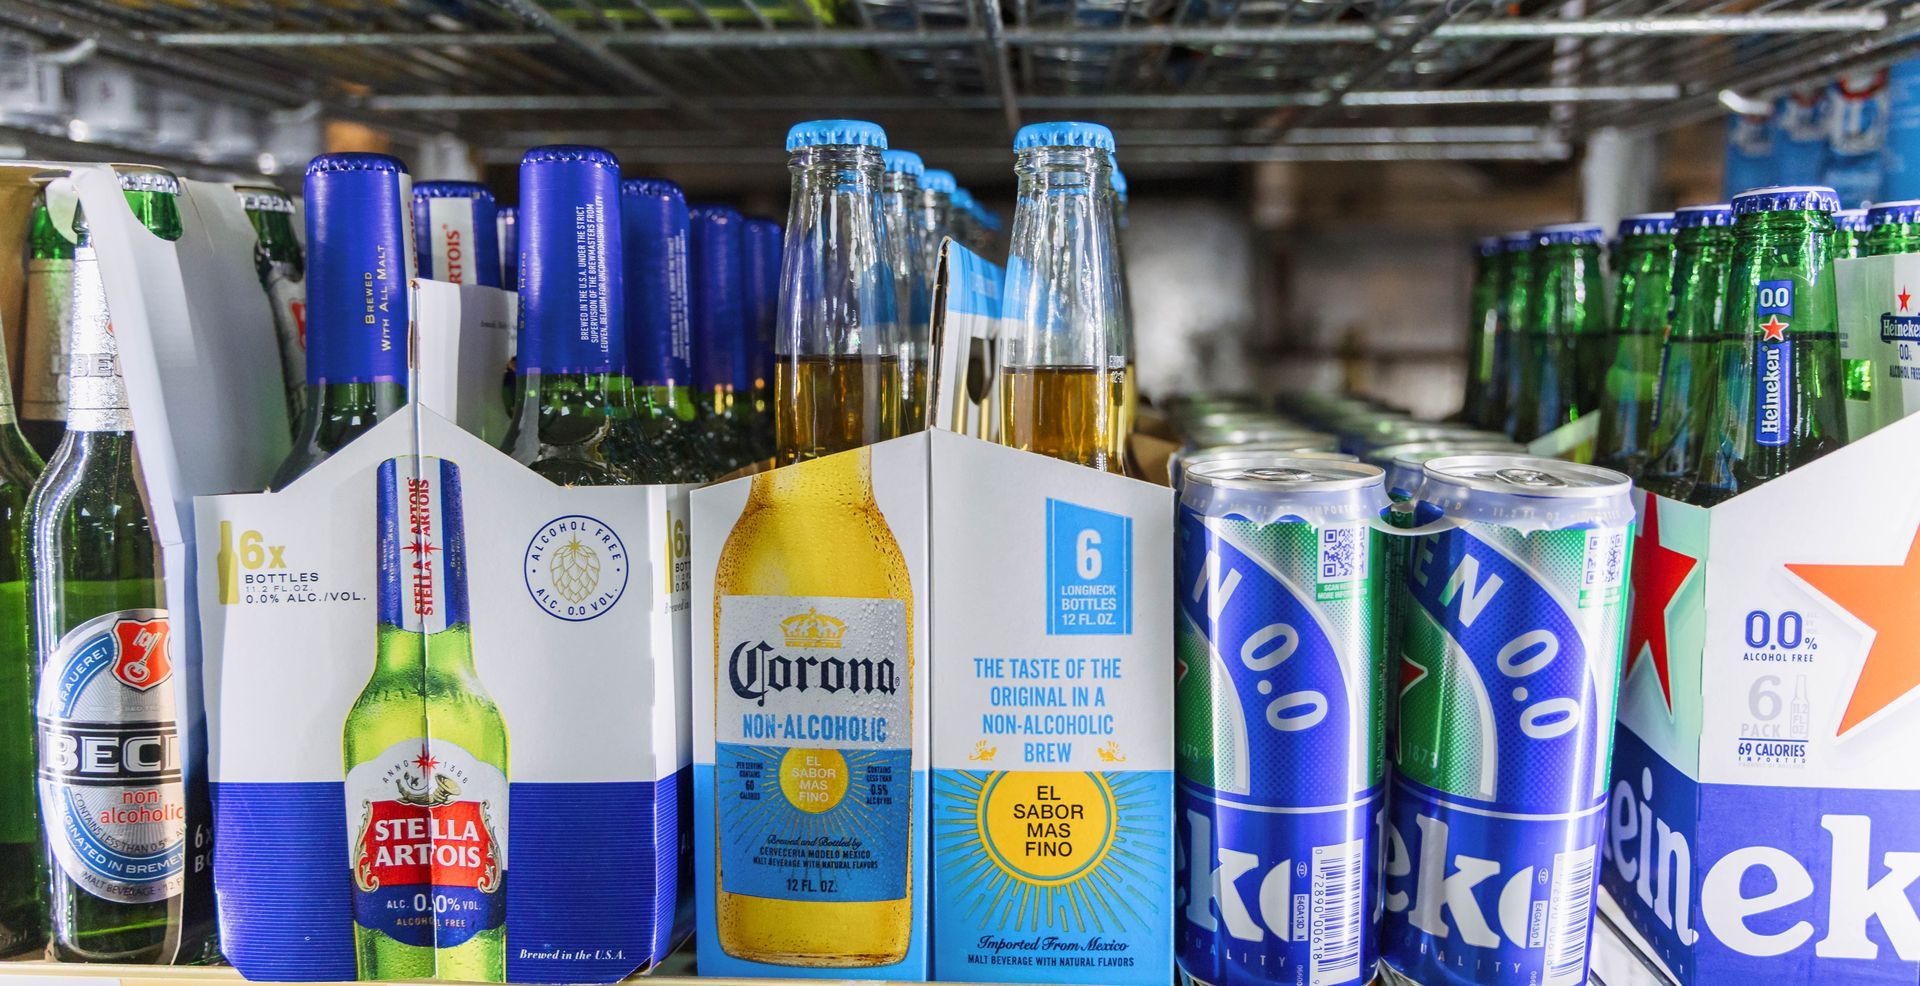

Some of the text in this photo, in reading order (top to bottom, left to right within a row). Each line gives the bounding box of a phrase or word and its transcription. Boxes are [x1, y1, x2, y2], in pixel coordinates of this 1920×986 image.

[576, 206, 589, 341] BREWED IN THE U.S.A. UNDER THE STRICT
[586, 204, 599, 344] SUPERVISION OF THE BREWMASTERS FROM
[364, 272, 376, 325] BREWED
[377, 244, 392, 352] WITH ALL MALT
[1760, 287, 1789, 308] 0.0
[599, 297, 608, 325] BELGIUM
[1761, 348, 1780, 434] Heineken
[240, 530, 288, 570] 6x
[531, 520, 622, 561] ALCOHOL FREE
[1076, 529, 1102, 580] 6
[245, 573, 320, 583] BOTTLES
[246, 592, 367, 604] 0.0% ALC./VOL.
[1061, 584, 1117, 597] LONGNECK
[536, 587, 619, 616] ALC. 0.0 VOL.
[1061, 598, 1117, 611] BOTTLES
[1062, 613, 1075, 625] 12
[1743, 652, 1814, 663] ALCOHOL FREE
[729, 639, 898, 708] Corona
[974, 658, 1122, 679] THE TASTE OF THE
[1240, 622, 1329, 732] 0.0
[1496, 629, 1581, 740] 0.0
[990, 687, 1106, 708] ORIGINAL IN A
[1748, 674, 1783, 722] 6
[742, 713, 888, 743] NON-ALCOHOLIC
[982, 714, 1114, 735] NON-ALCOHOLIC
[1741, 722, 1782, 739] PACK
[1024, 743, 1072, 764] BREW
[1738, 742, 1806, 757] 69 CALORIES
[806, 756, 821, 766] EL
[1738, 756, 1806, 764] IMPORTED
[382, 761, 409, 784] ANNO
[791, 768, 836, 778] SABOR
[799, 780, 828, 790] MAS
[1037, 785, 1061, 801] EL
[798, 791, 829, 803] FINO
[100, 804, 185, 825] alcoholic
[1013, 803, 1084, 820] SABOR
[74, 792, 149, 854] CONTAINS LESS THAN
[374, 817, 481, 842] STELLA
[1027, 822, 1071, 839] MAS
[801, 836, 817, 846] and
[1024, 841, 1073, 857] FINO
[374, 843, 482, 868] ARTOIS
[808, 849, 840, 859] MODELO
[107, 861, 122, 871] IN
[786, 879, 799, 892] 12
[801, 880, 817, 892] FL.
[386, 899, 410, 910] ALC.
[462, 900, 482, 911] VOL.
[445, 918, 466, 928] FREE
[977, 935, 1129, 954] Imported From Mexico
[519, 949, 626, 961] Brewed in the U.S.A.
[967, 954, 1135, 967] MALT BEVERAGE WITH NATURAL FLAVORS
